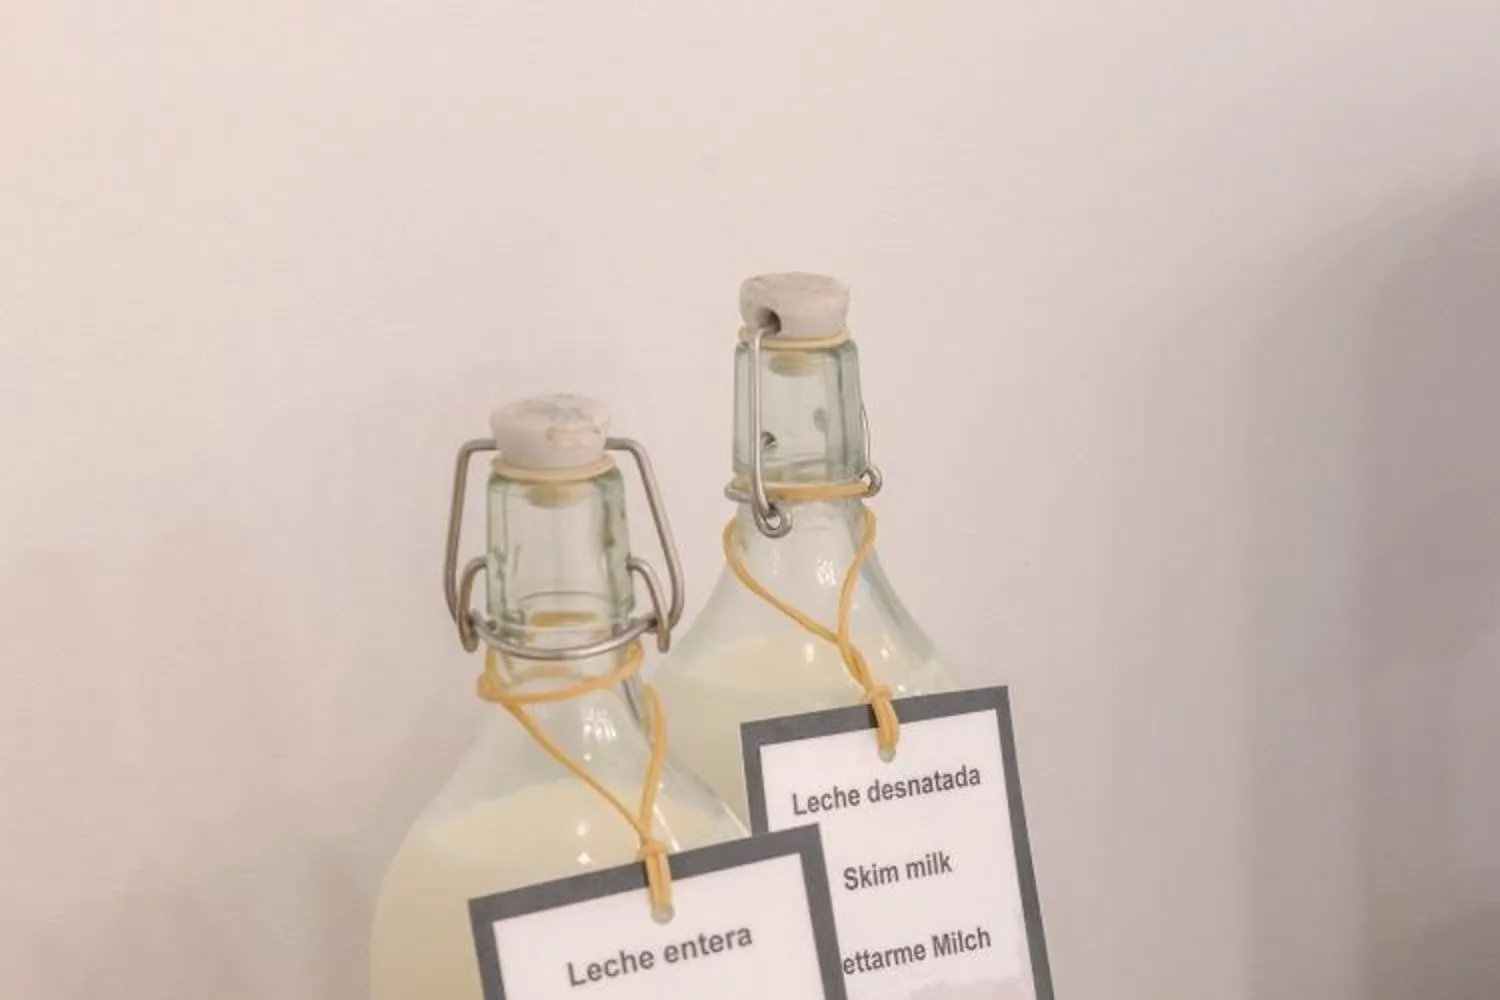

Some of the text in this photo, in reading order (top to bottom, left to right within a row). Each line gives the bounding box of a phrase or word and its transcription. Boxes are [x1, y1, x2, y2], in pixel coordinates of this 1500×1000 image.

[791, 764, 982, 816] Leche desnatada
[842, 850, 953, 892] Skim milk
[566, 926, 754, 988] Leche entera
[842, 926, 992, 976] ettarme Milch
